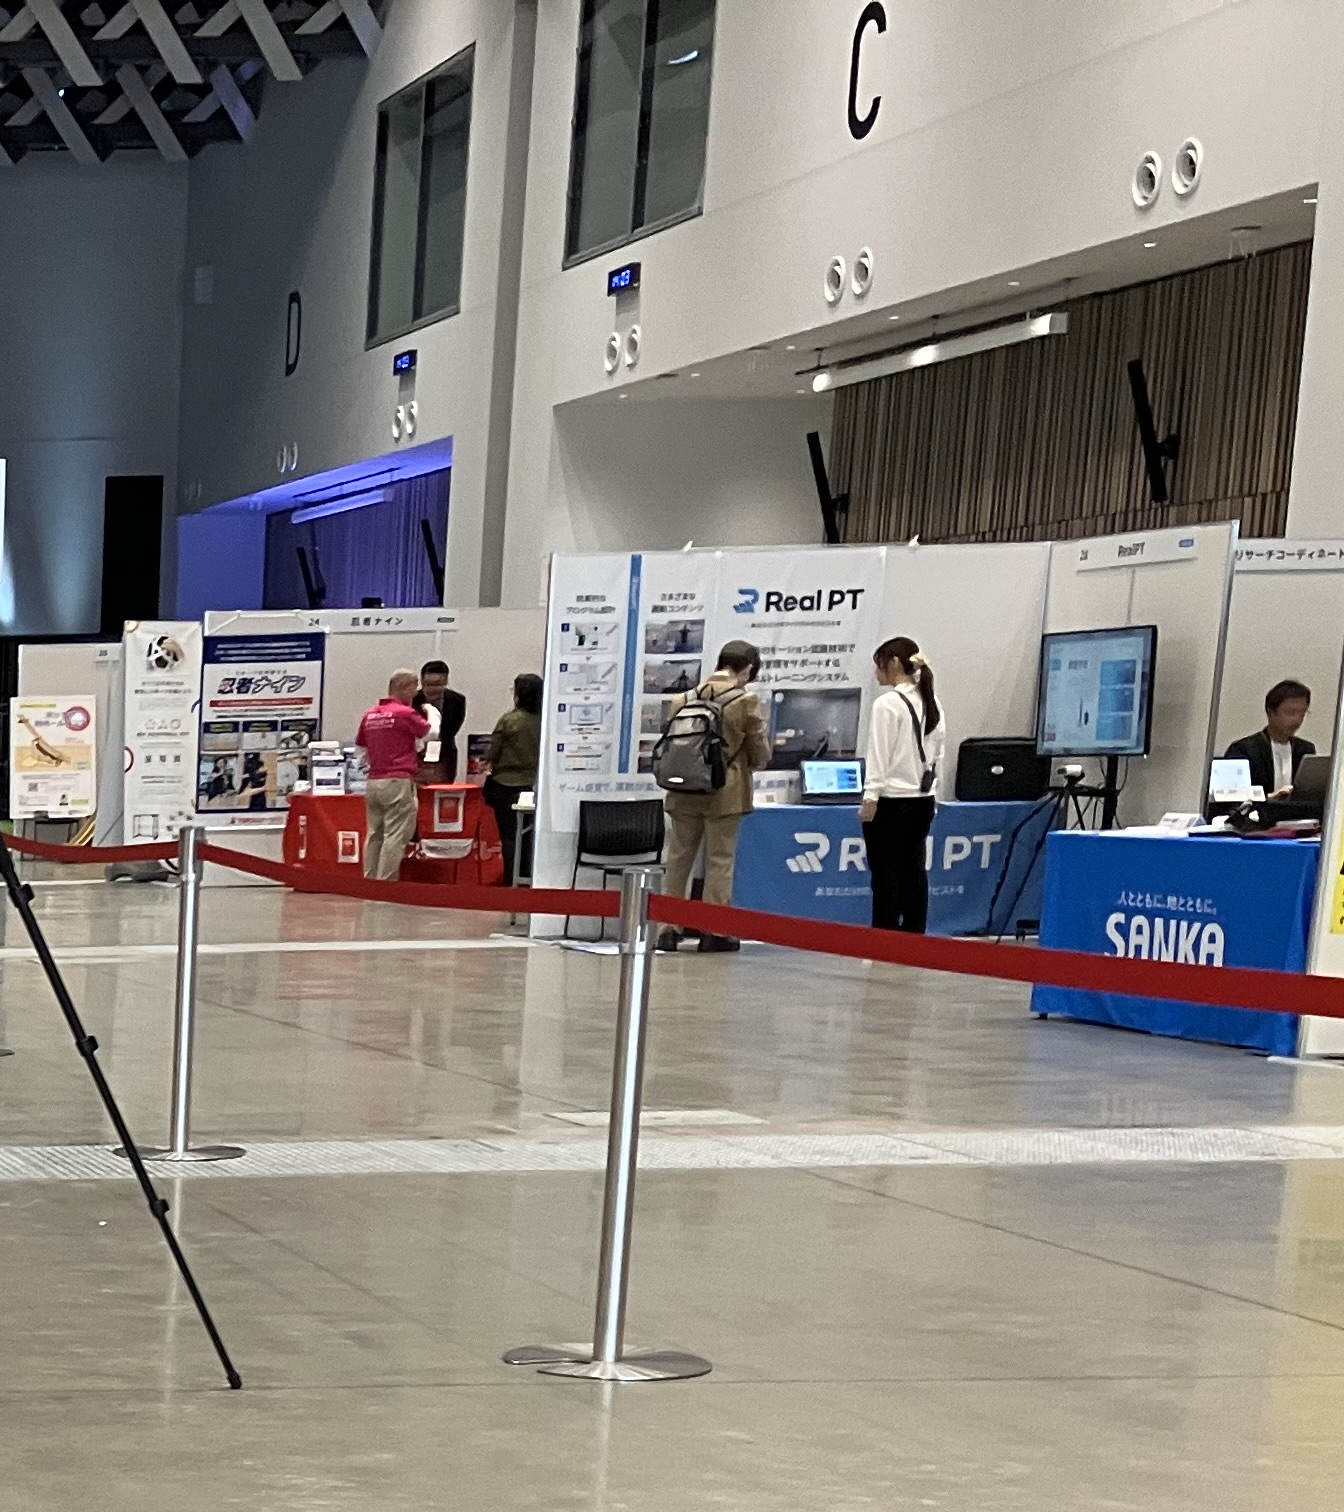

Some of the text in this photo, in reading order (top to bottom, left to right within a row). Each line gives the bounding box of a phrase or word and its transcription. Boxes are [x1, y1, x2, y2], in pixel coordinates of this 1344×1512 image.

[847, 1, 888, 141] C
[764, 588, 865, 613] Real PT
[942, 833, 1003, 871] PT
[1103, 911, 1226, 968] SANKA
